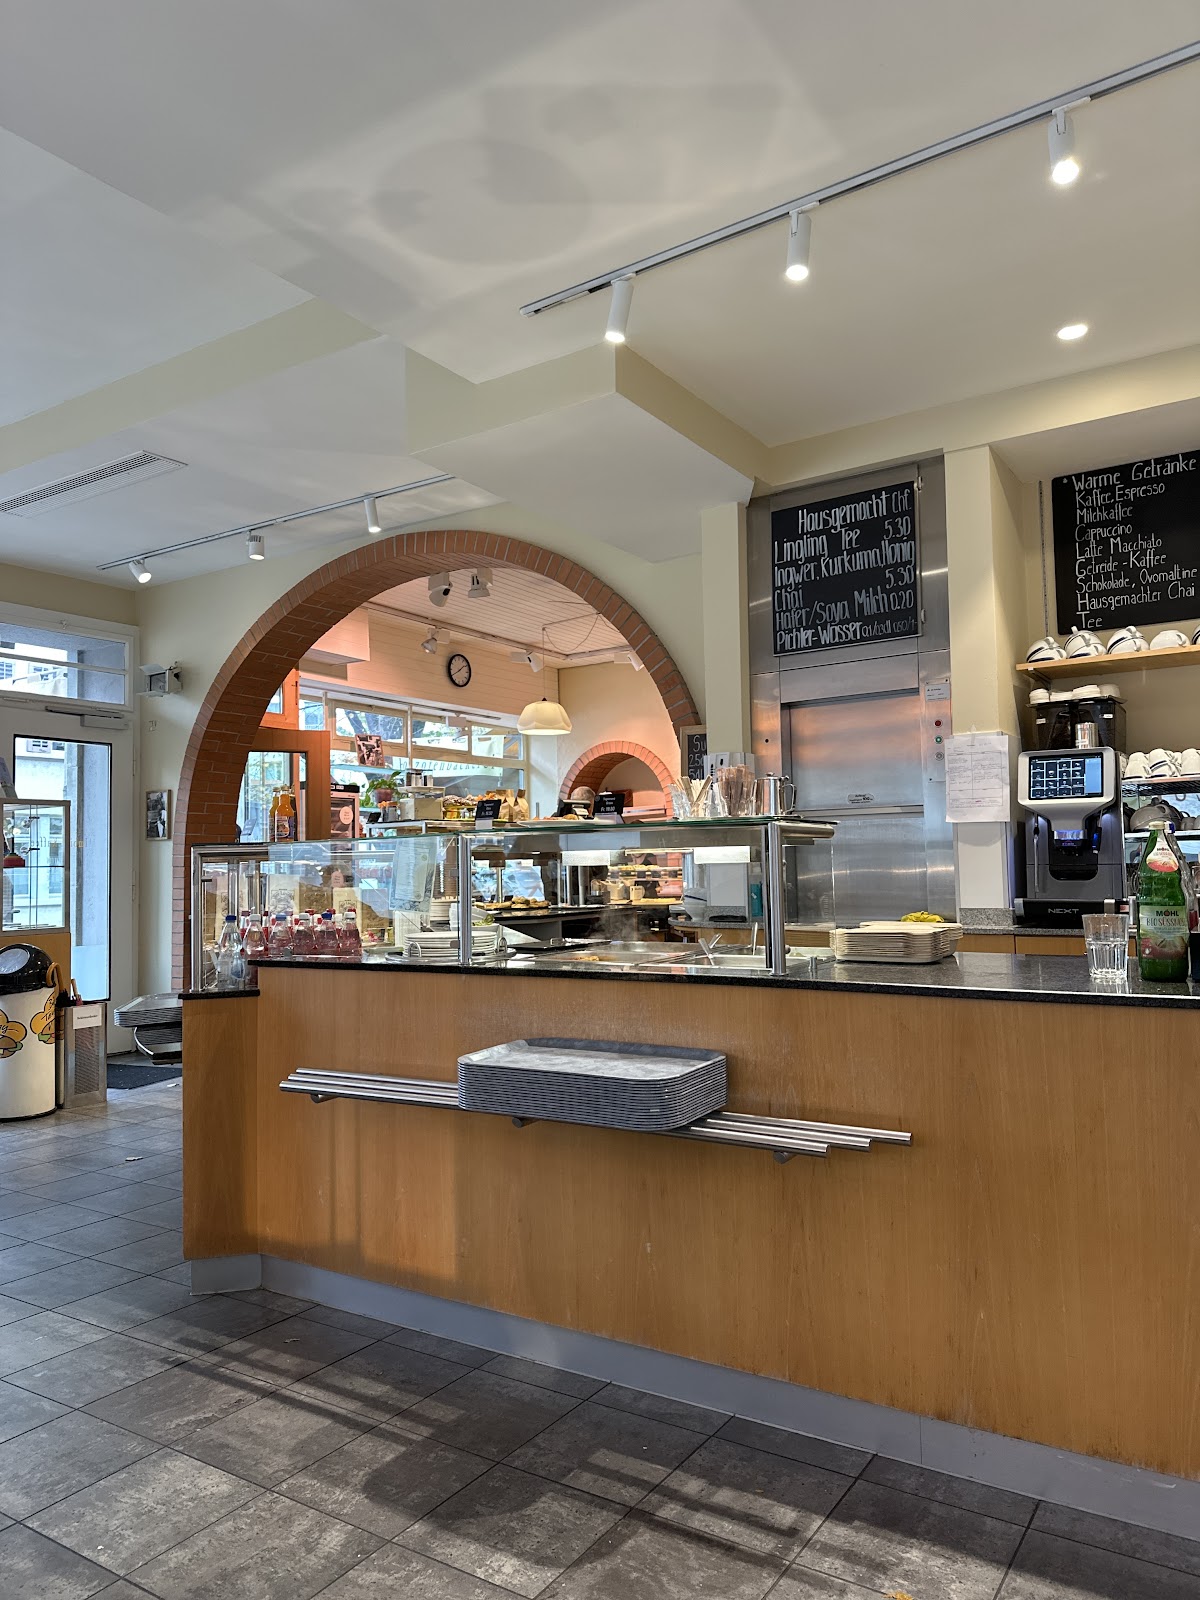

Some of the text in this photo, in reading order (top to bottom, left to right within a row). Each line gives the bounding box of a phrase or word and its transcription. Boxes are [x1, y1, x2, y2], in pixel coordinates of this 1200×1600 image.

[1072, 453, 1197, 492] Warme Getränke
[798, 490, 890, 534] Hausgemacht
[1076, 502, 1133, 525] Milchkaffee
[774, 516, 911, 564] Lingling Tee 5.30
[1075, 524, 1133, 542] Cappuccino
[1075, 533, 1163, 559] Latte Macchiato
[774, 564, 914, 612] Chai 5.30
[1140, 564, 1198, 585] Ovomaltine
[854, 586, 889, 617] Milch
[1077, 581, 1195, 612] Hausgemachter Chai
[1076, 611, 1103, 629] Tee
